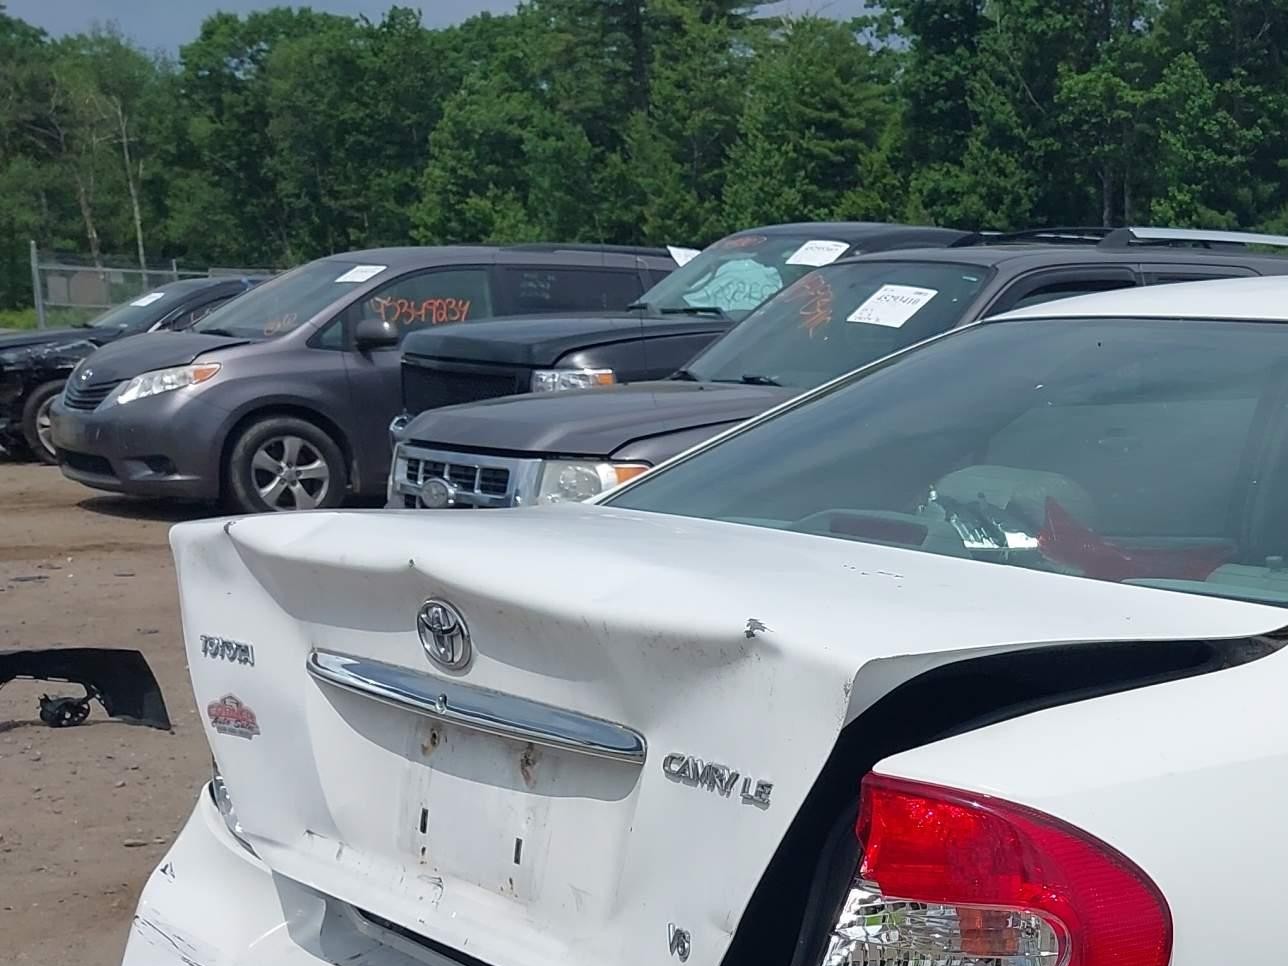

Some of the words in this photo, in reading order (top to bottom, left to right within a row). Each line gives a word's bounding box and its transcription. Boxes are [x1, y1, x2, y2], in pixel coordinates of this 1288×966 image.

[199, 634, 256, 668] TOYOTA
[662, 753, 740, 799] CAMRY
[740, 777, 774, 811] LE
[667, 922, 691, 963] V6
